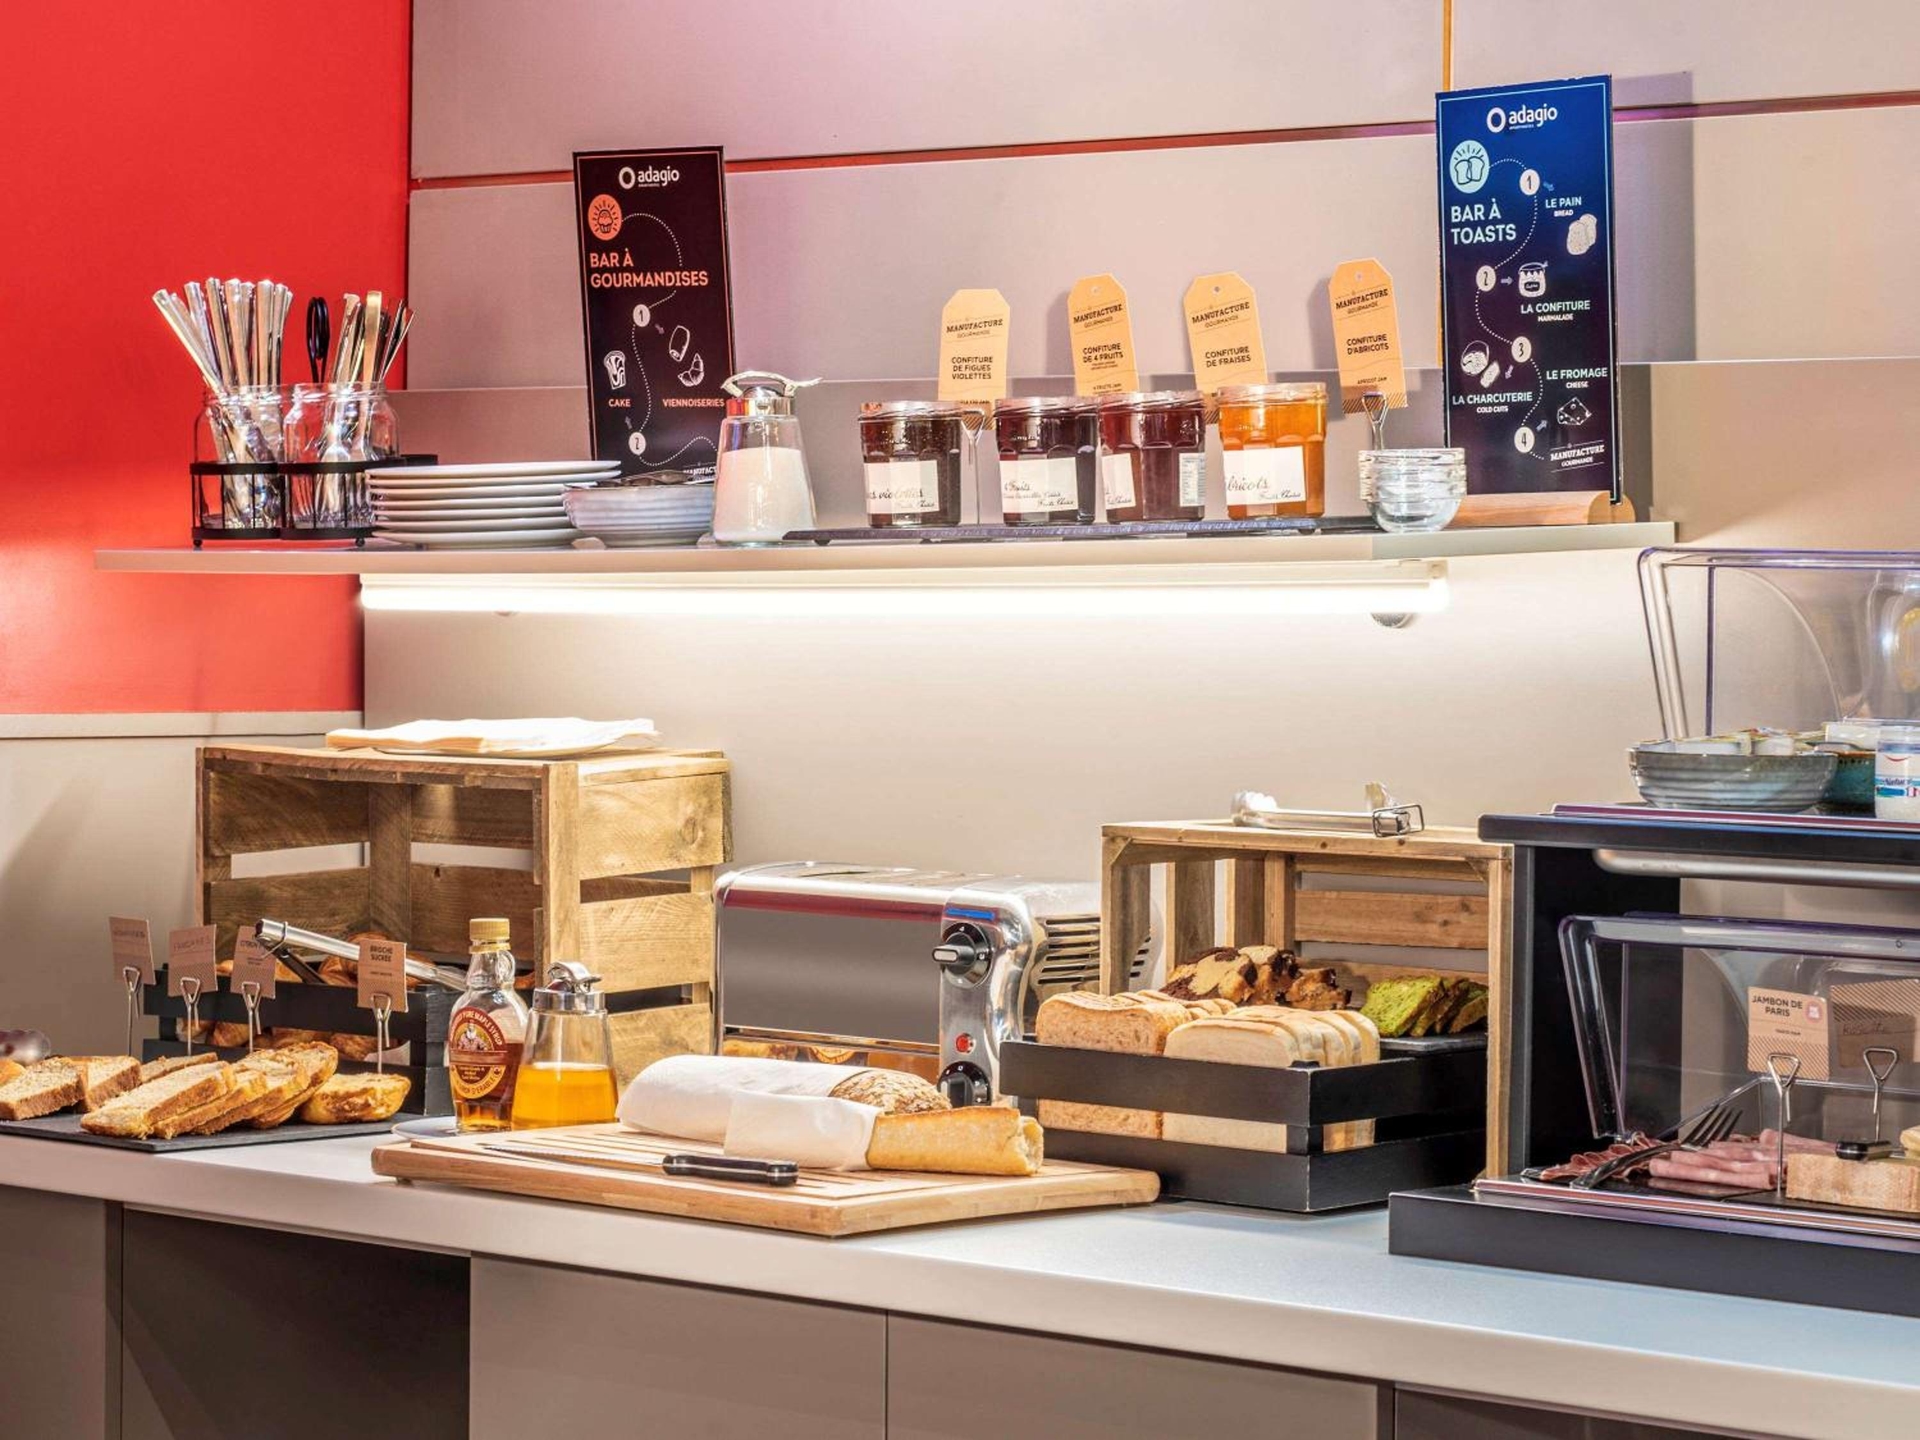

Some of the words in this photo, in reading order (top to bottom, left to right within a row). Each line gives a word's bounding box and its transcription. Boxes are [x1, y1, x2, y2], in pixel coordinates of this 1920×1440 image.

[1508, 103, 1558, 127] adagio
[637, 165, 680, 187] adagio
[1545, 199, 1557, 208] LE
[1559, 196, 1582, 207] PAIN
[1451, 204, 1485, 223] BAR
[1488, 198, 1501, 220] À
[1553, 209, 1574, 217] BREAD
[1451, 223, 1517, 245] TOASTS
[590, 252, 619, 268] BAR
[622, 247, 634, 267] À
[590, 270, 709, 288] GOURMANDISES
[1335, 288, 1389, 310] MANUFACTURE
[1073, 303, 1123, 324] MANUFACTURE
[1191, 301, 1250, 324] MANUFACTURE
[1521, 304, 1534, 314] LA
[1535, 300, 1591, 312] CONFITURE
[1537, 313, 1574, 322] MARMALADE
[946, 318, 1003, 333] MANUFACTURE
[1346, 333, 1387, 347] CONFITURE
[1082, 342, 1122, 355] CONFITURE
[1205, 346, 1250, 359] CONFITURE
[1347, 342, 1389, 355] D'ABRICOTS
[951, 356, 993, 364] CONFITURE
[1082, 355, 1092, 363] DE
[1099, 351, 1124, 361] FRUITS
[1206, 359, 1217, 368] DE
[1218, 354, 1251, 365] FRAISES
[952, 364, 963, 372] DE
[964, 364, 991, 372] FIGUES
[1546, 370, 1558, 380] LE
[1560, 367, 1608, 379] FROMAGE
[951, 372, 992, 380] VIOLETTES
[1565, 381, 1589, 389] CHEESE
[608, 398, 631, 408] CAKE
[662, 398, 725, 408] VIENNOISERIES
[1452, 395, 1465, 405] LA
[1466, 391, 1533, 404] CHARCUTERIE
[1550, 444, 1605, 461] MANUFACTURE
[1227, 475, 1270, 492] bricots
[1751, 995, 1789, 1008] JAMBON
[1790, 1000, 1803, 1010] DE
[1764, 1006, 1791, 1017] PARIS
